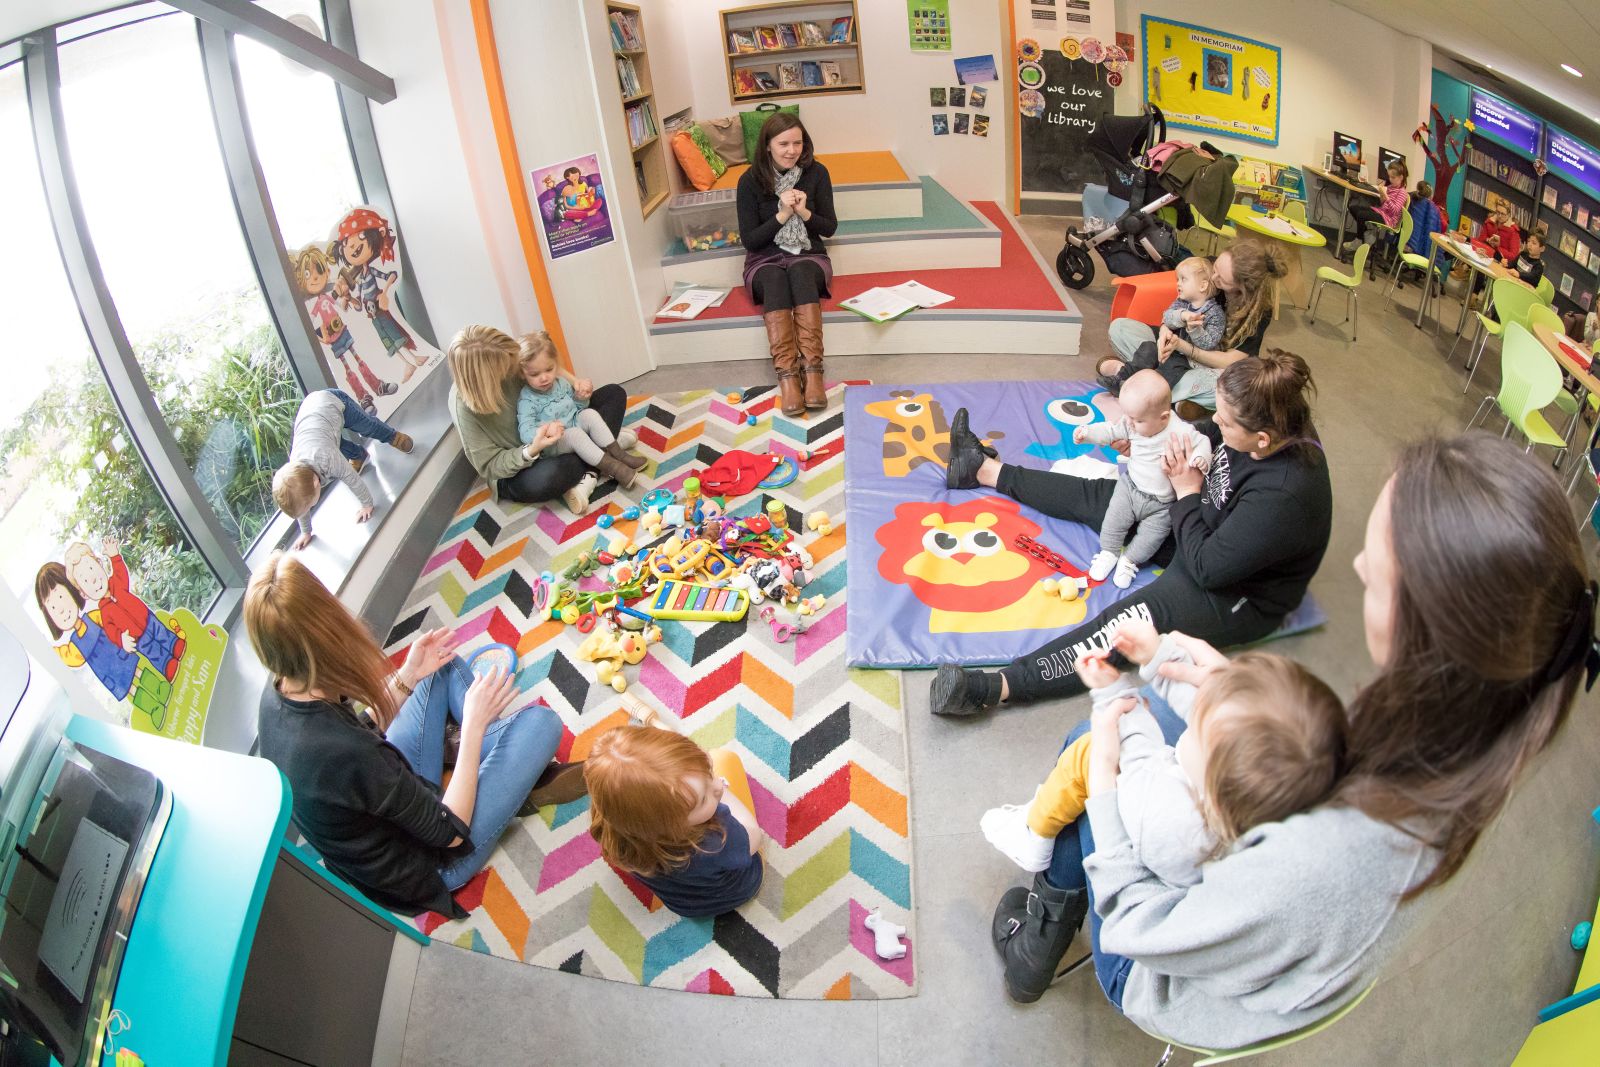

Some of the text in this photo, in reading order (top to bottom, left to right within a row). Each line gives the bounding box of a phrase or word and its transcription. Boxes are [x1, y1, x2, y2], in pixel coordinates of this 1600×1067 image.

[1191, 34, 1243, 52] IN MEMORIAM
[1047, 84, 1102, 98] we love
[1060, 101, 1086, 111] our
[1475, 102, 1505, 120] Discover
[1047, 112, 1096, 134] library
[1551, 141, 1580, 160] Discover
[1037, 646, 1077, 681] NYC
[192, 659, 212, 691] Sam
[191, 687, 201, 708] and
